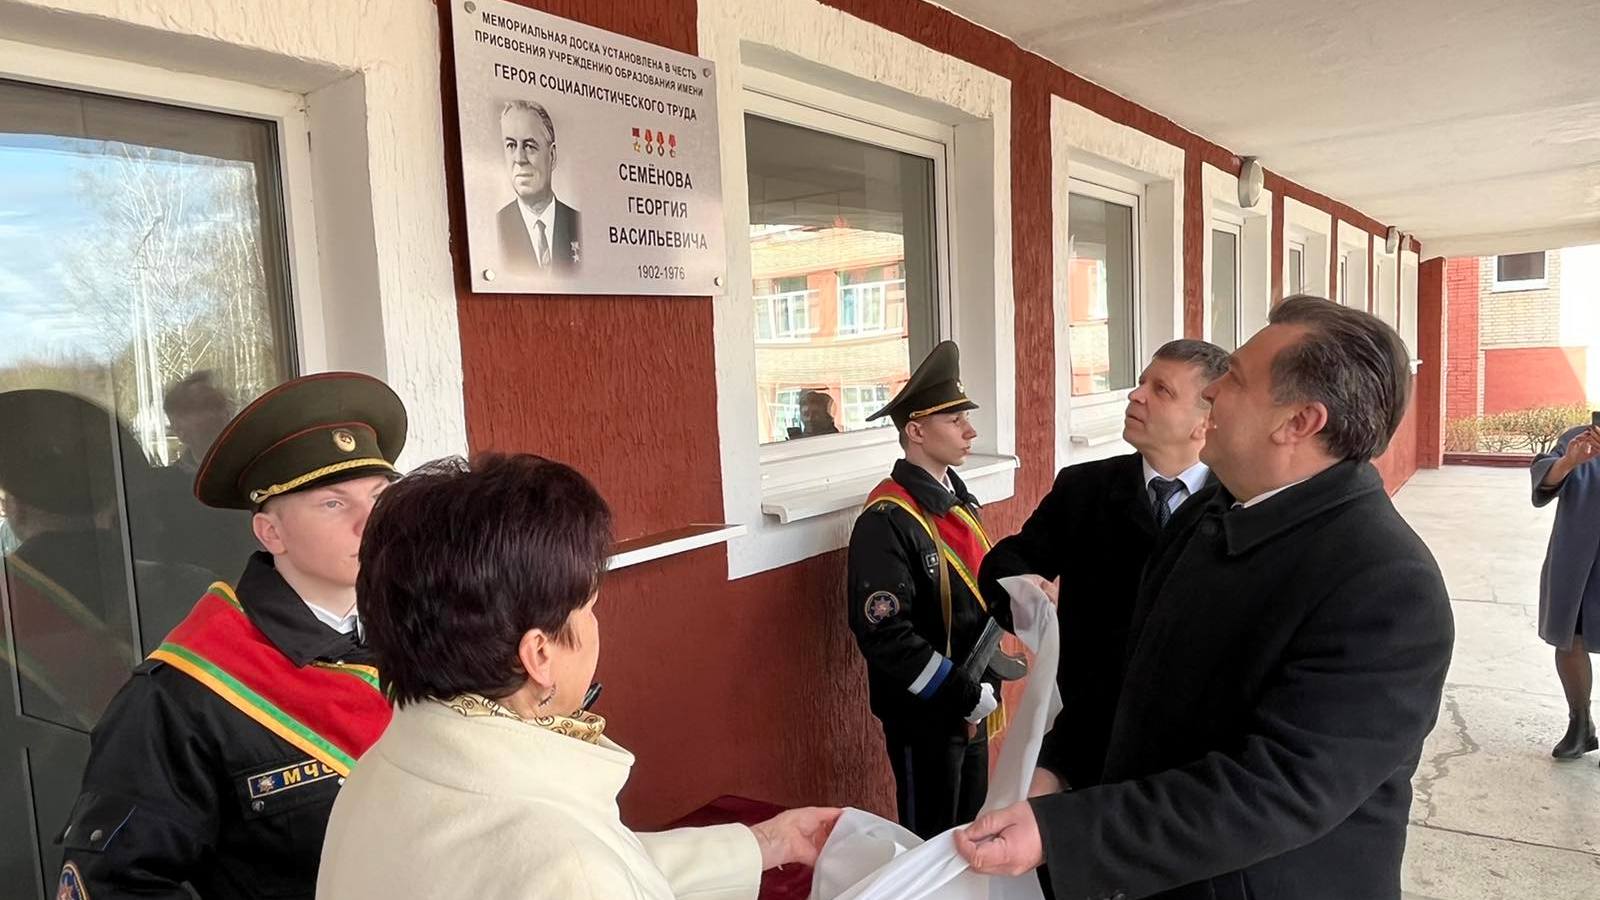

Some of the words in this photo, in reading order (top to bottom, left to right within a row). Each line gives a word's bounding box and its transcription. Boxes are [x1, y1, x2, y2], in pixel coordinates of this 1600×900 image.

[482, 12, 567, 45] МЕМОРИАЛЬНАЯ
[569, 36, 600, 55] ДОСКА
[602, 45, 663, 72] УСТАНОВЛЕНА
[665, 61, 670, 73] В
[673, 65, 697, 80] ЧЕСТЬ
[475, 30, 546, 58] ПРИСВОЕНИЯ
[548, 49, 612, 75] УЧРЕЖДЕНИЮ
[615, 67, 675, 91] ОБРАЗОВАНИЯ
[677, 83, 704, 97] ИМЕНИ
[494, 63, 536, 86] ГЕРОЯ
[540, 74, 664, 113] СОЦИАЛИСТИЧЕСКОГО
[666, 102, 697, 121] ТРУДА
[619, 163, 693, 189] СЕМЁНОВА
[628, 196, 688, 218] ГЕОРГИЯ
[609, 226, 707, 249] ВАСИЛЬЕВИЧА
[637, 265, 685, 280] 1902-1976
